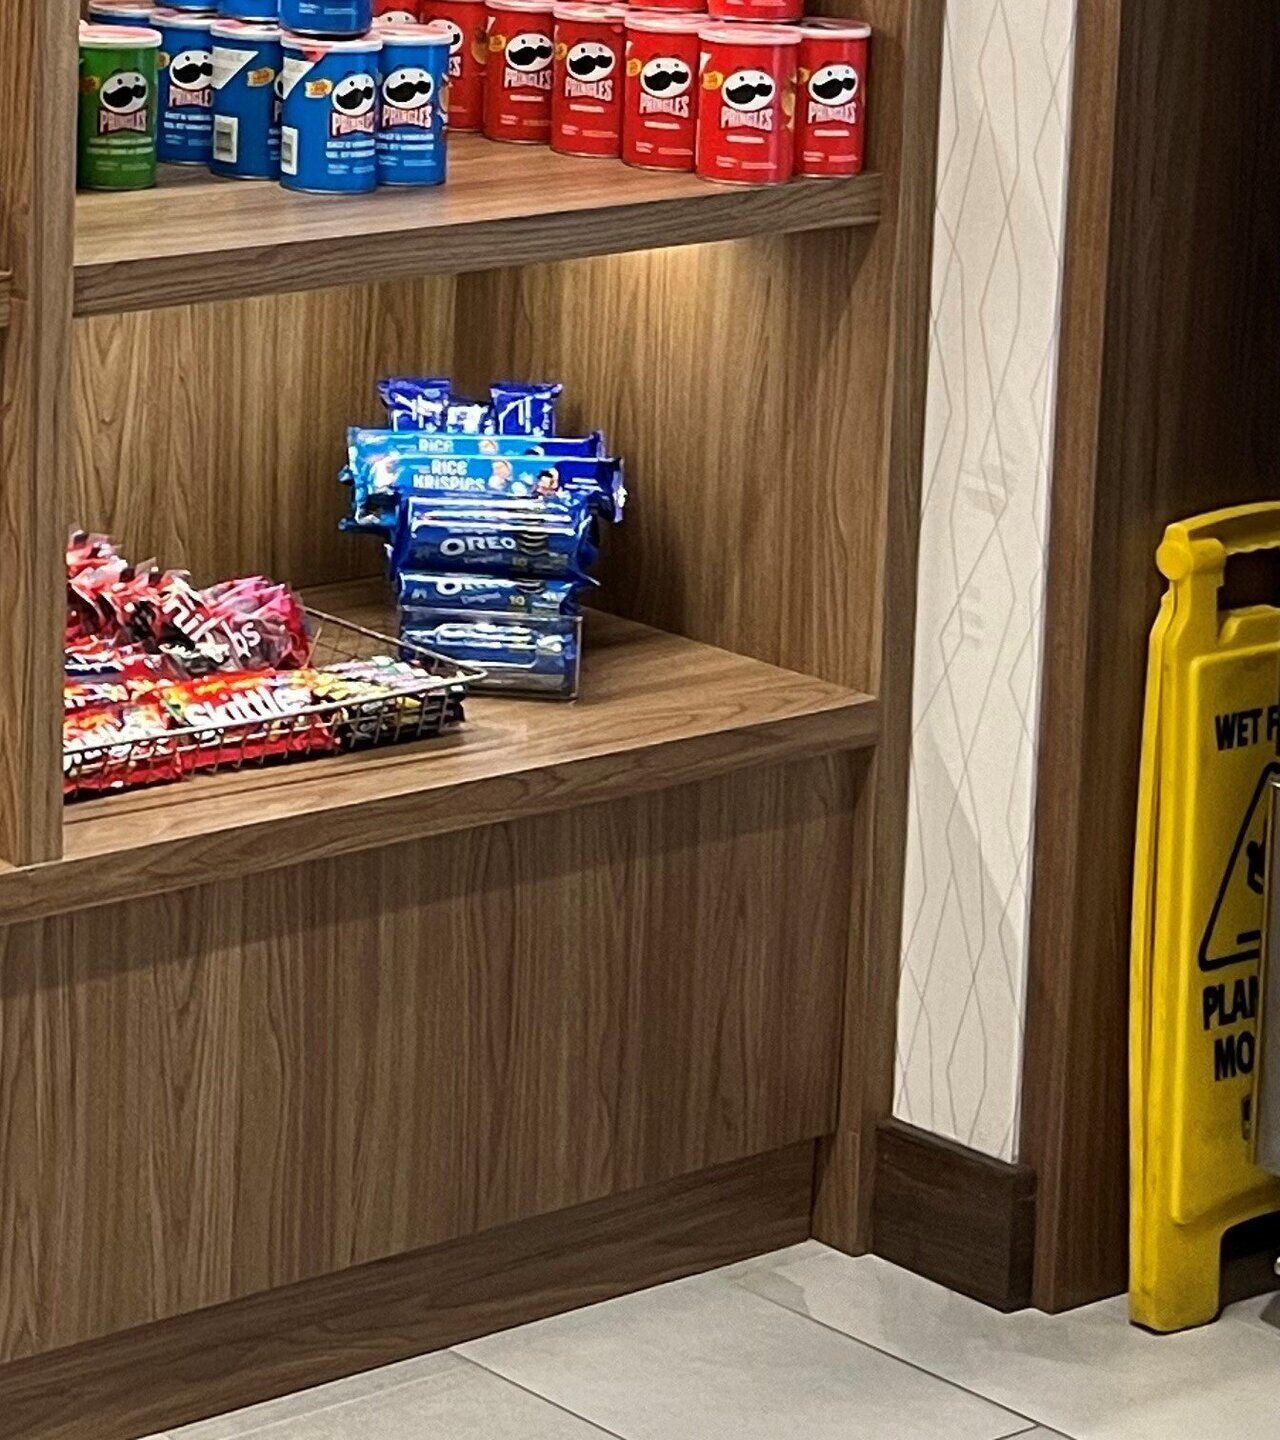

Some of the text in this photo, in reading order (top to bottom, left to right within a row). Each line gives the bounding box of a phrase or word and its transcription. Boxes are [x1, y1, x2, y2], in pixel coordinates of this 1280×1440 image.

[382, 103, 433, 129] PRINGLES
[439, 536, 517, 556] OREO
[1214, 707, 1264, 752] WET
